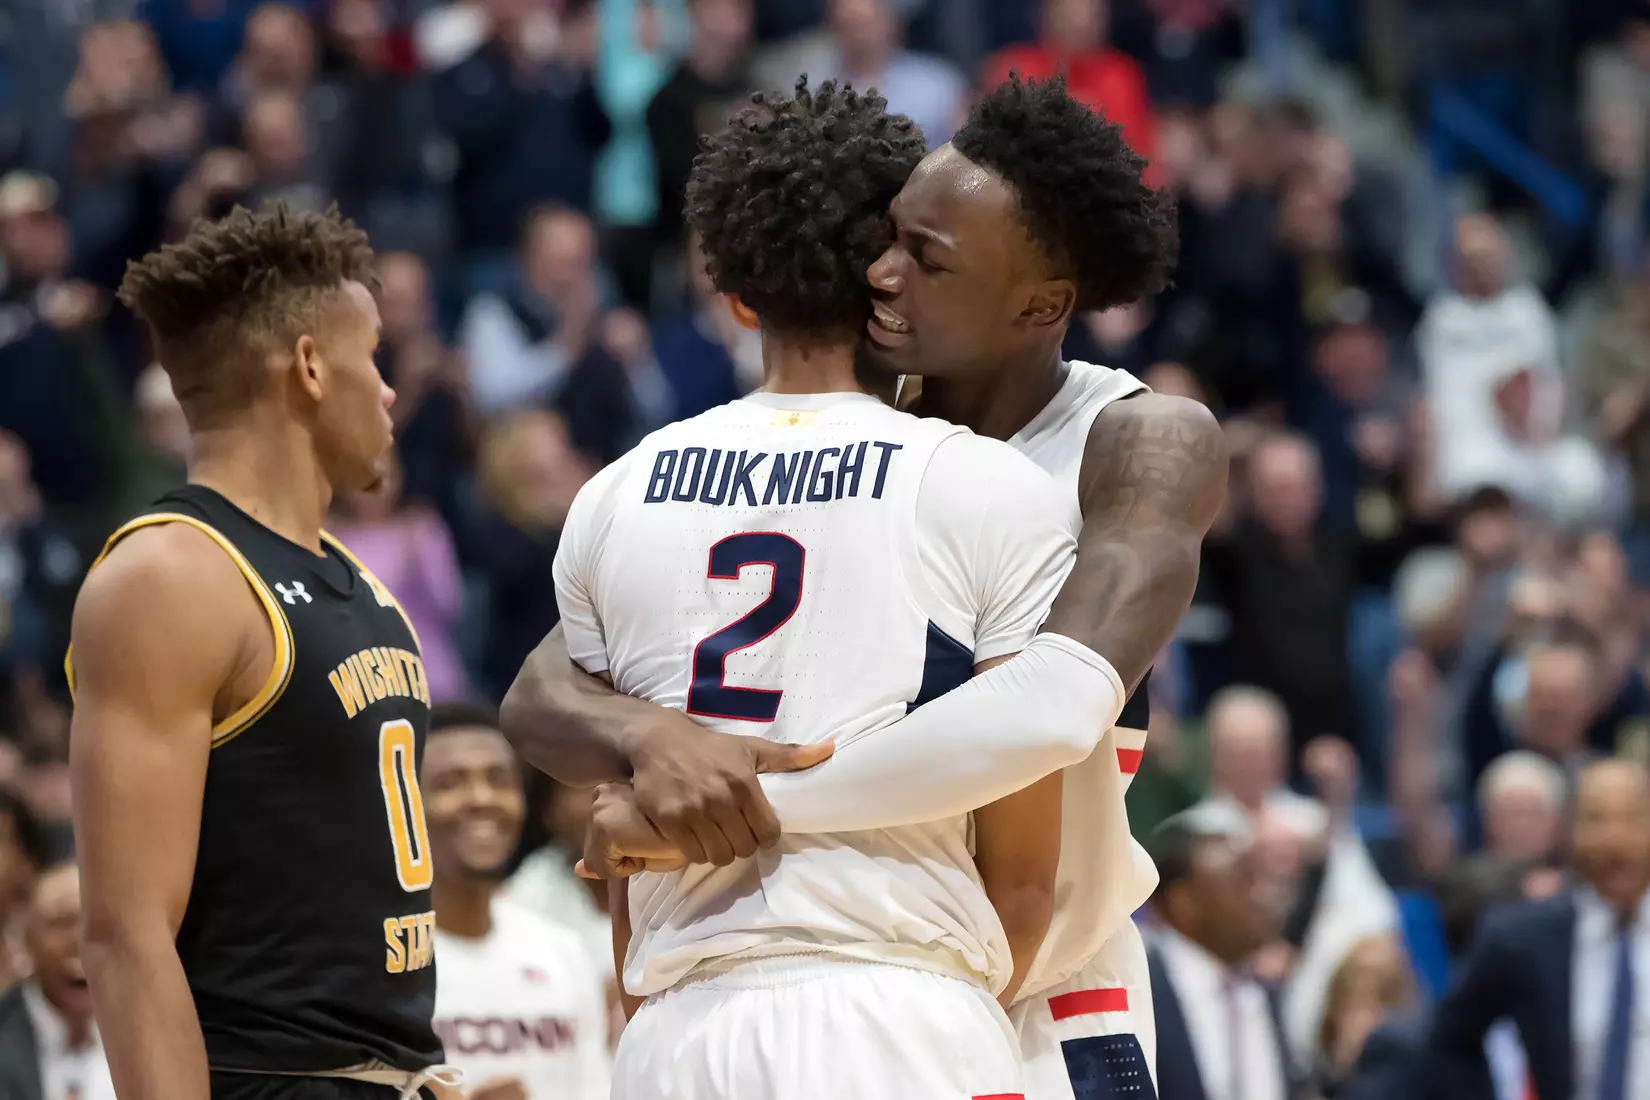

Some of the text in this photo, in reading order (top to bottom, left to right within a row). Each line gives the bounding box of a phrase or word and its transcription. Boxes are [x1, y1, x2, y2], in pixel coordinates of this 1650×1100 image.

[643, 440, 903, 506] BOUKNIGHT
[687, 531, 806, 722] 2
[379, 718, 433, 892] 0
[383, 910, 436, 973] STAT
